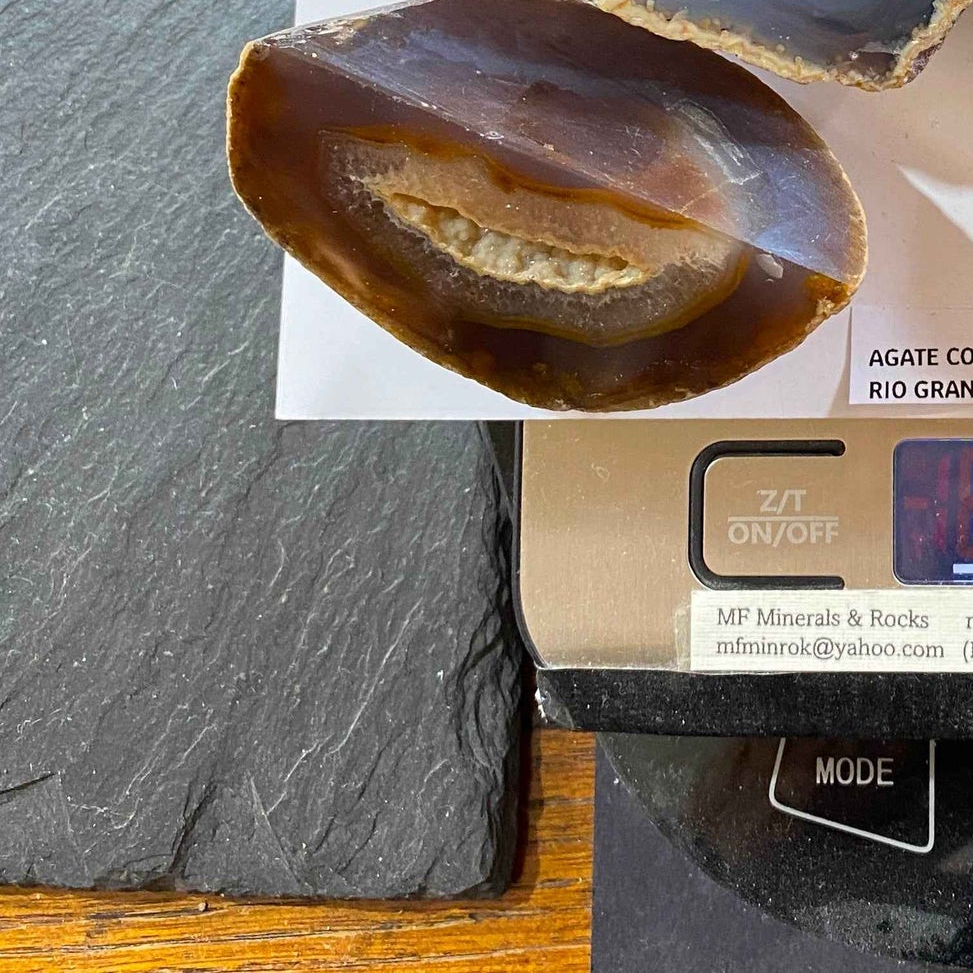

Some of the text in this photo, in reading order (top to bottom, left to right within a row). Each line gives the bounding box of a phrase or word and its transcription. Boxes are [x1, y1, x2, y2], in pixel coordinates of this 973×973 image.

[868, 348, 939, 367] AGATE
[868, 380, 906, 399] RIO
[756, 489, 807, 515] Z/T
[727, 521, 839, 547] ON/OFF
[717, 608, 929, 628] MF Minerals & Rocks
[717, 638, 945, 660] mfminrok@yahoo.com
[815, 757, 894, 787] MODE
